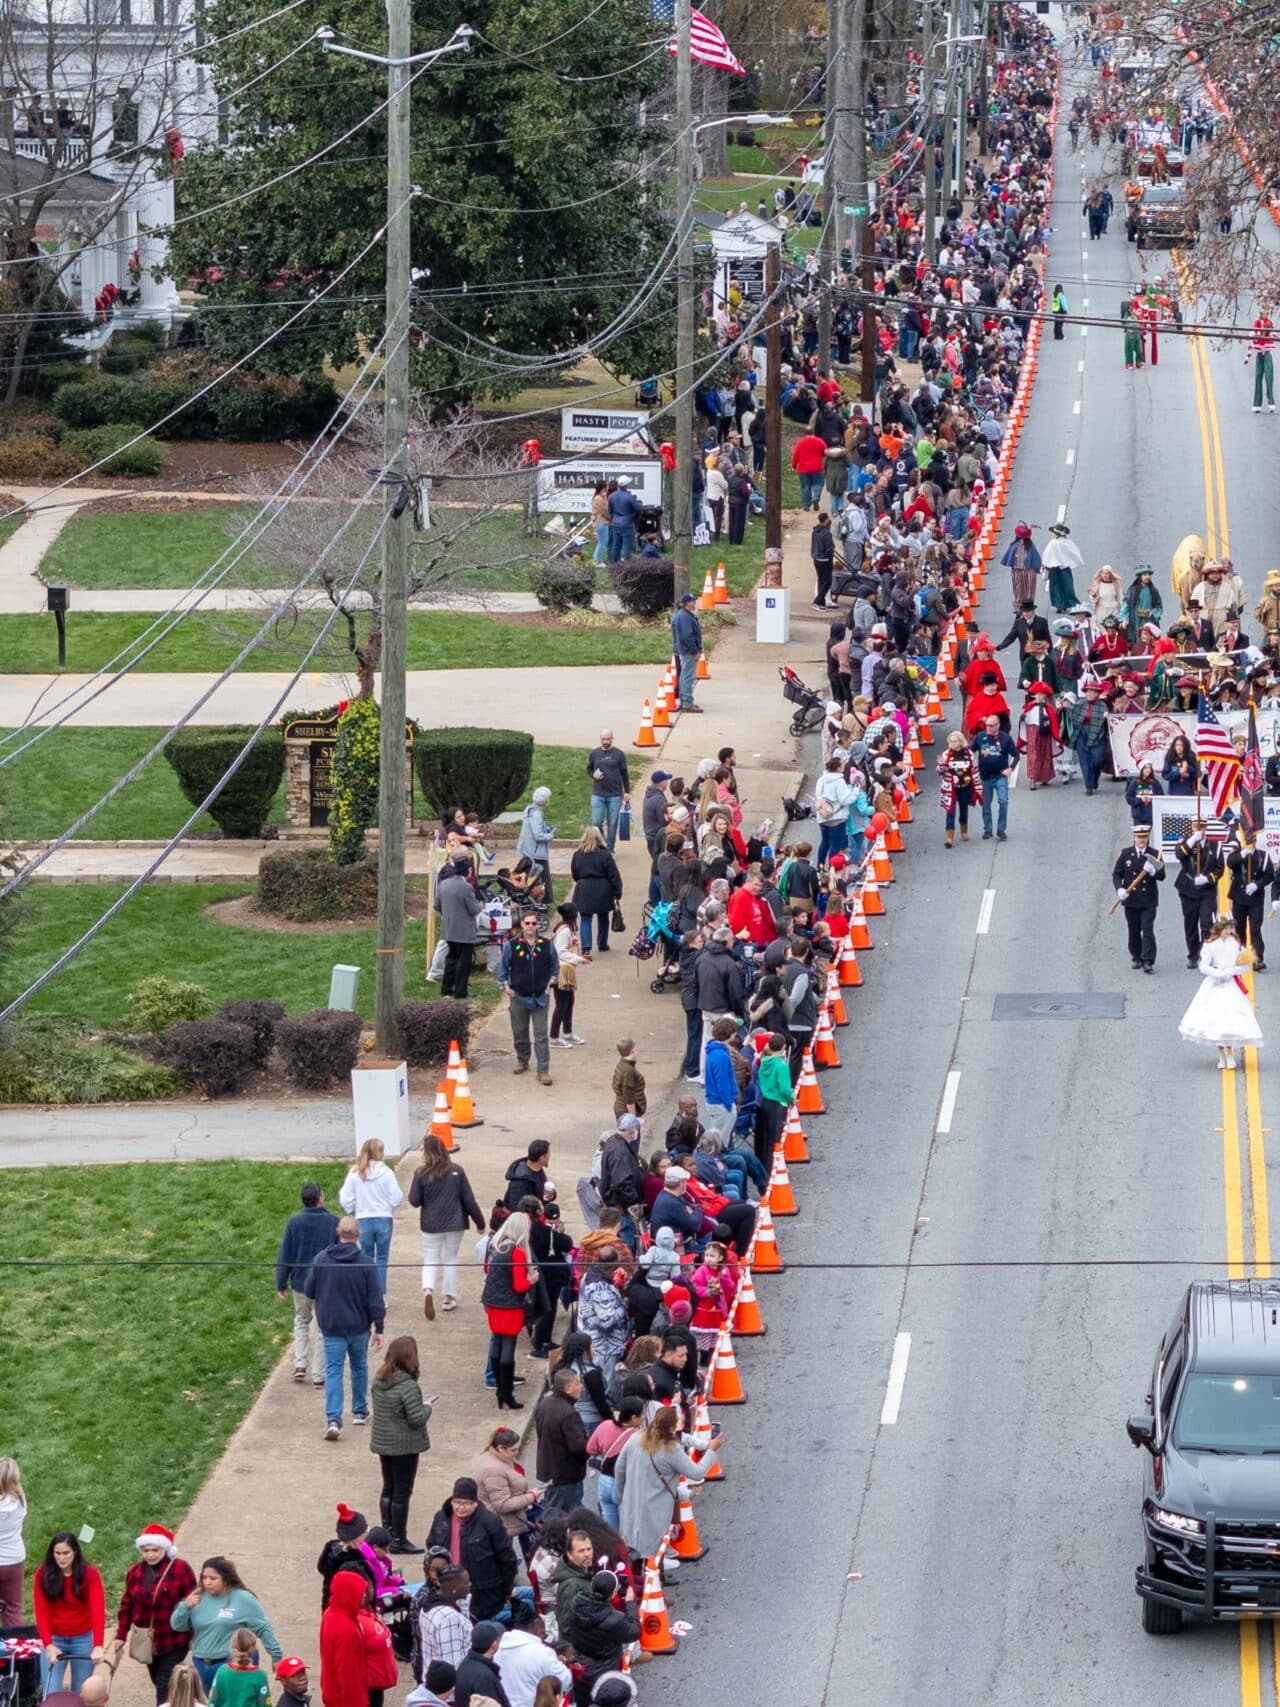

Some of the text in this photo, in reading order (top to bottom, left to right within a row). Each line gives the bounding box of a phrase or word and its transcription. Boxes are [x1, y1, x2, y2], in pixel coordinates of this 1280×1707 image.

[574, 416, 636, 427] HASTY POPE
[558, 475, 641, 485] HASTY PE
